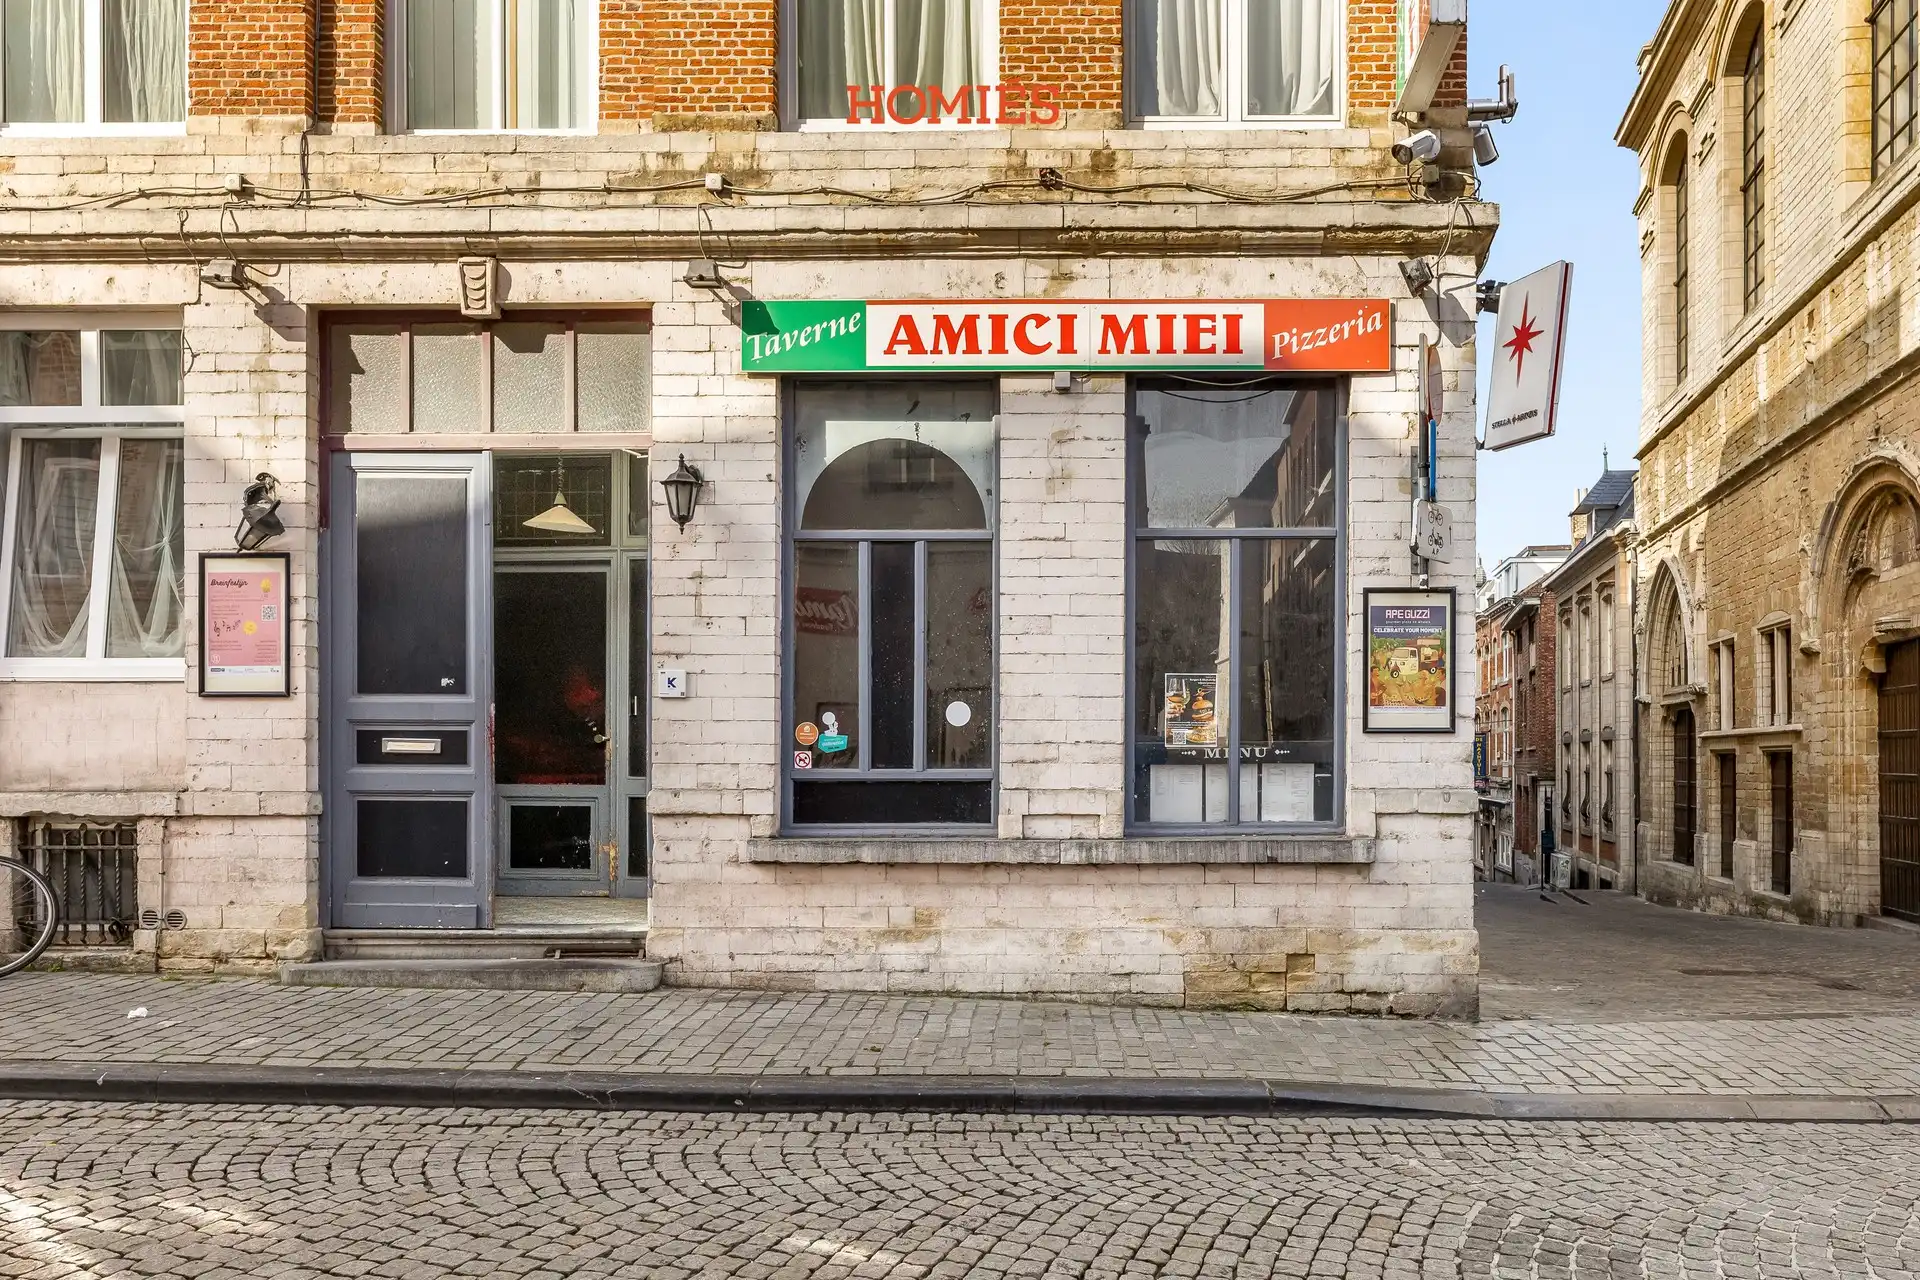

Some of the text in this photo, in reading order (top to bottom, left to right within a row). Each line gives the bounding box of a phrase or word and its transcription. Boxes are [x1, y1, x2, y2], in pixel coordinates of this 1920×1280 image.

[746, 311, 861, 363] Taverne
[883, 313, 1243, 355] AMICI MIEI
[1272, 307, 1382, 360] Pizzeria
[1491, 418, 1511, 430] STELLA
[1386, 609, 1403, 619] APE
